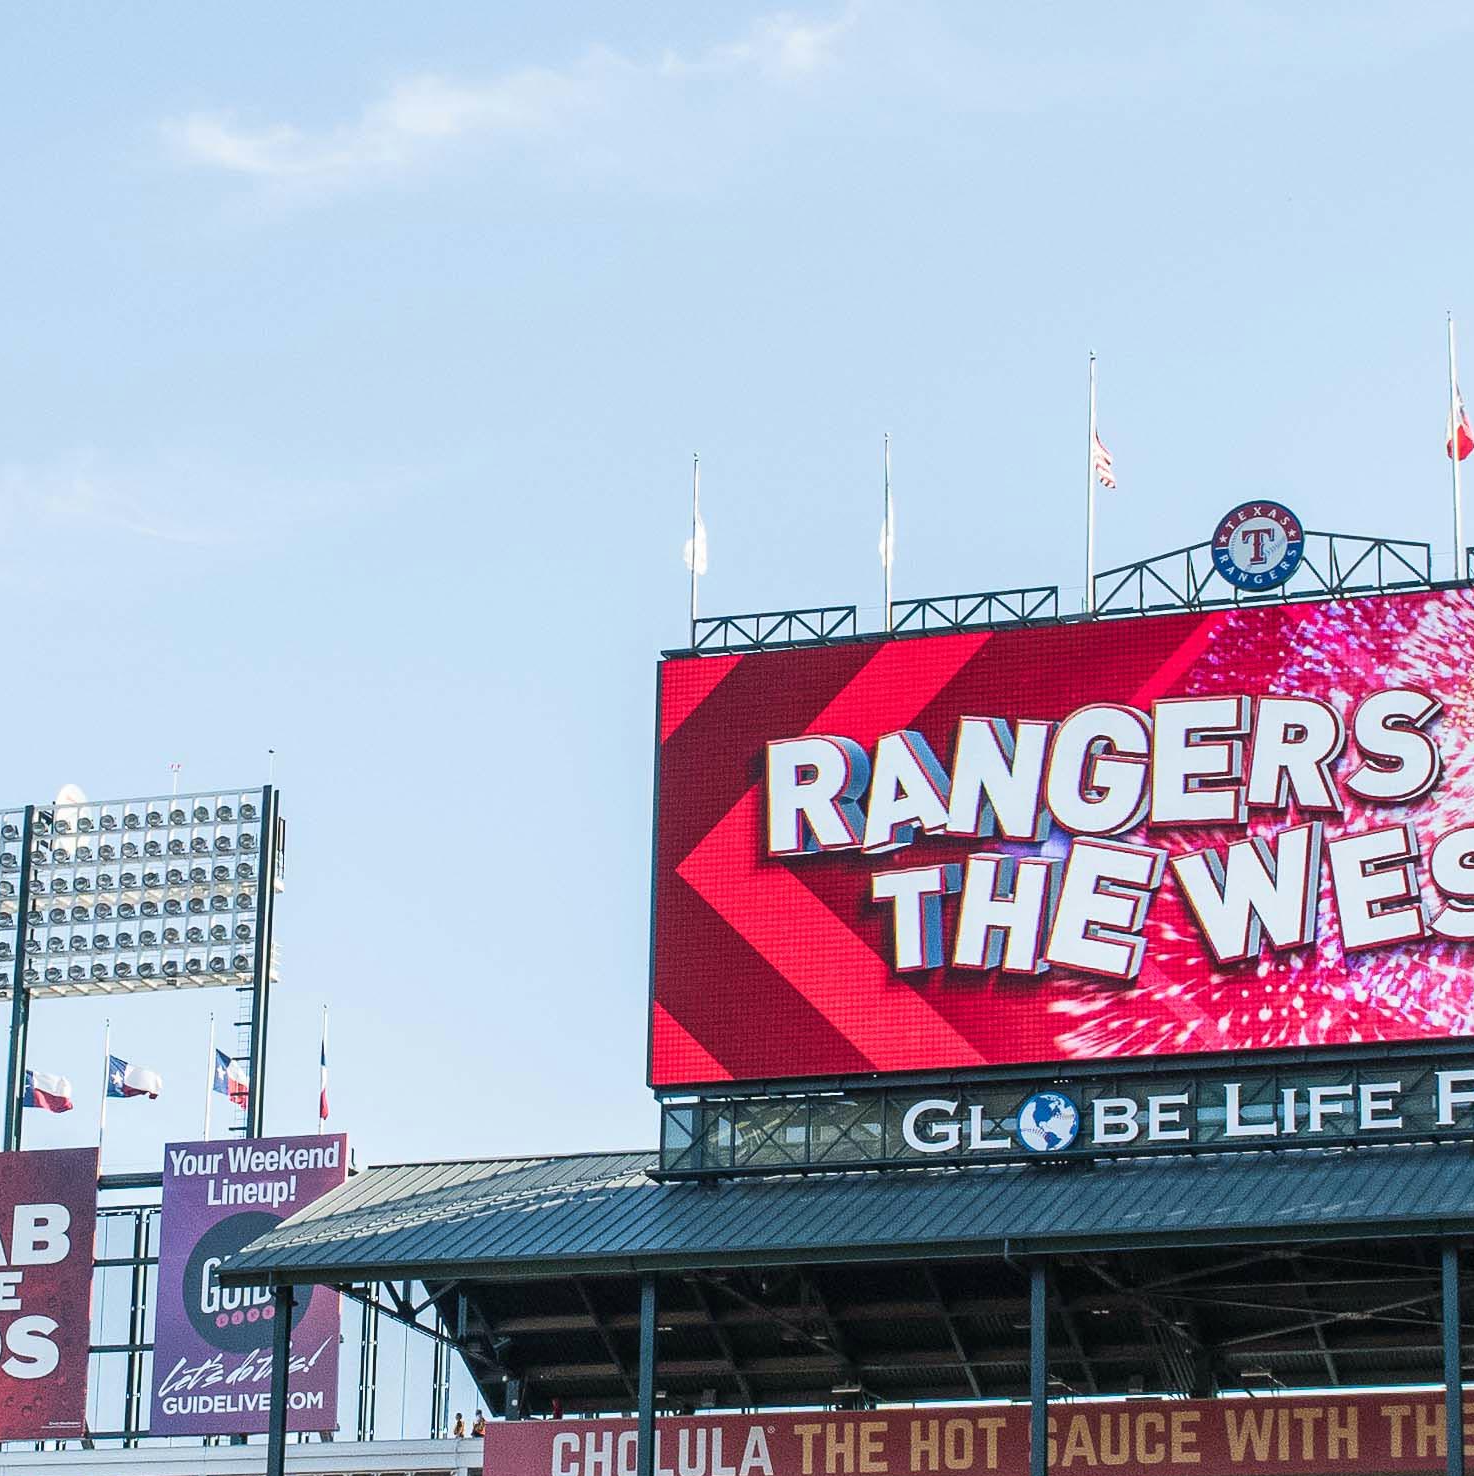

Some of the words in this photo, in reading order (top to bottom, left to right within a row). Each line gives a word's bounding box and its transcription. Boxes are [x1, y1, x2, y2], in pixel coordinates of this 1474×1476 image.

[1225, 506, 1291, 530] TEXAS
[1241, 528, 1275, 565] T
[1219, 549, 1297, 584] RANGERS
[766, 688, 1443, 858] RANGERS
[871, 837, 1170, 981] THE
[1223, 1082, 1404, 1140] LIFE
[170, 1148, 224, 1177] Your
[227, 1141, 341, 1175] Weekend
[207, 1175, 297, 1208] Lineup!
[158, 1353, 225, 1398] Let's
[162, 1391, 325, 1415] GUIDELIVECOM
[794, 1422, 888, 1475] THE
[910, 1416, 1008, 1471] HOT
[1225, 1405, 1359, 1462] WITH
